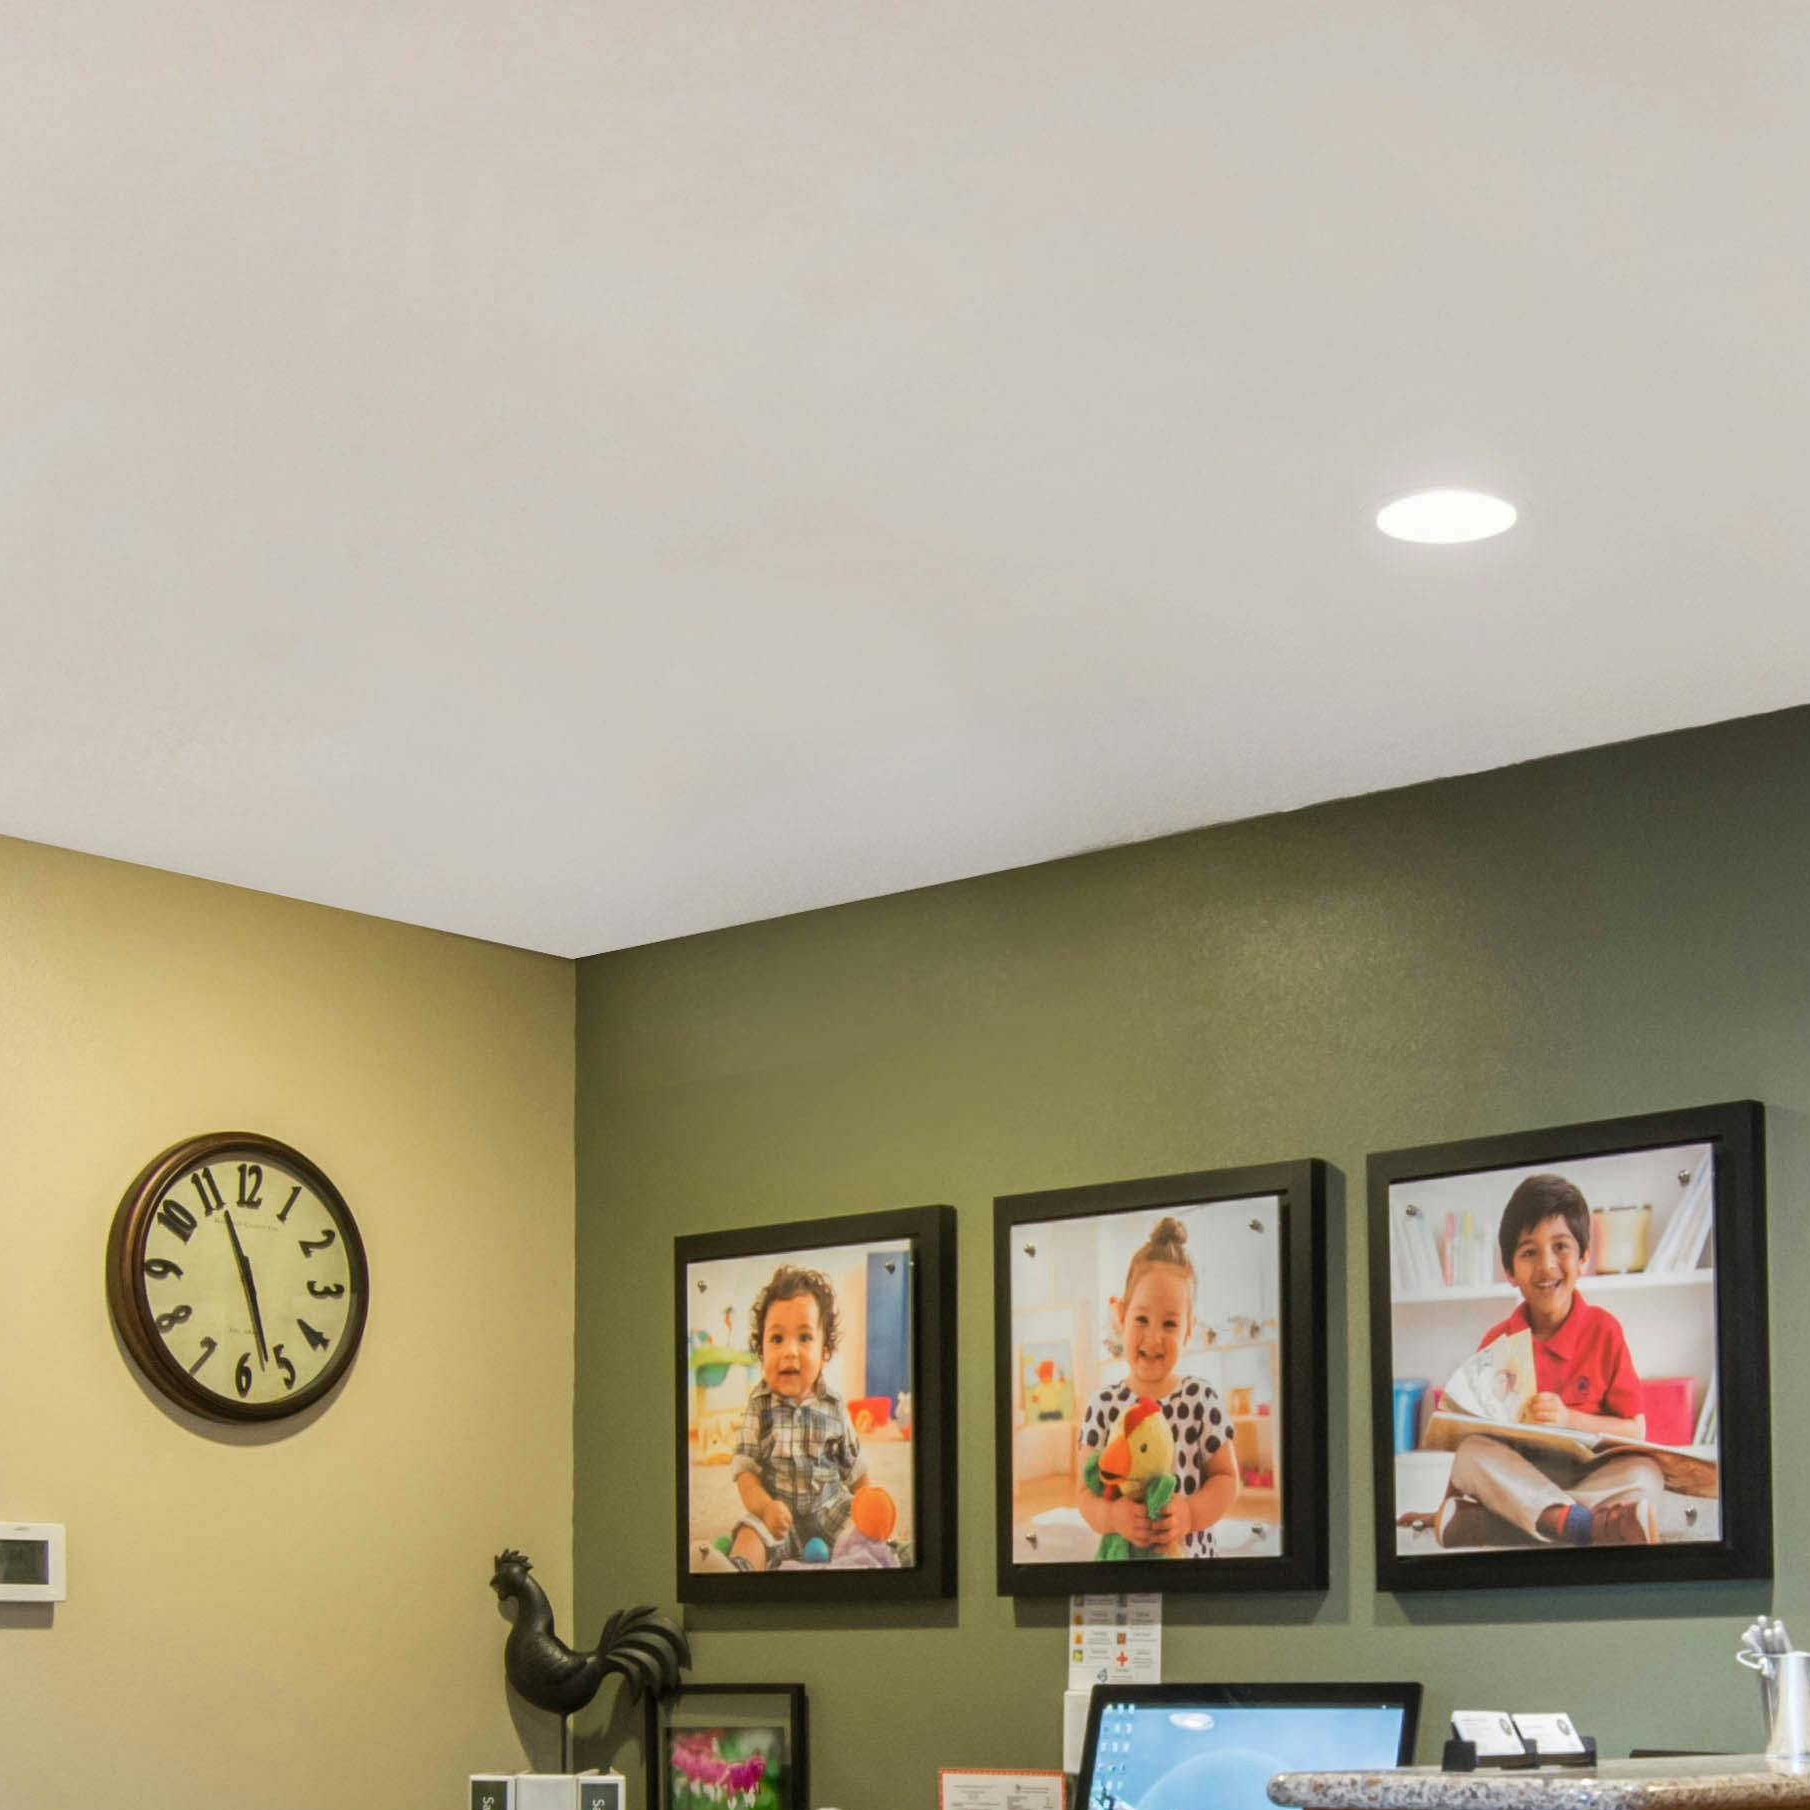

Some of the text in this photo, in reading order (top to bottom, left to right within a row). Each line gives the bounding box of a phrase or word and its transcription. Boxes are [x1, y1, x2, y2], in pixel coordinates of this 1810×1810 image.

[191, 1167, 226, 1217] 11
[237, 1163, 263, 1209] 12
[276, 1186, 302, 1223] 1
[157, 1198, 198, 1245] 10
[299, 1229, 336, 1258] 2
[144, 1258, 184, 1280] 9
[306, 1280, 345, 1300] 3
[156, 1304, 192, 1334] 8
[296, 1318, 331, 1352] 4
[188, 1336, 218, 1377] 7
[235, 1352, 253, 1398] 6
[273, 1344, 296, 1390] 5
